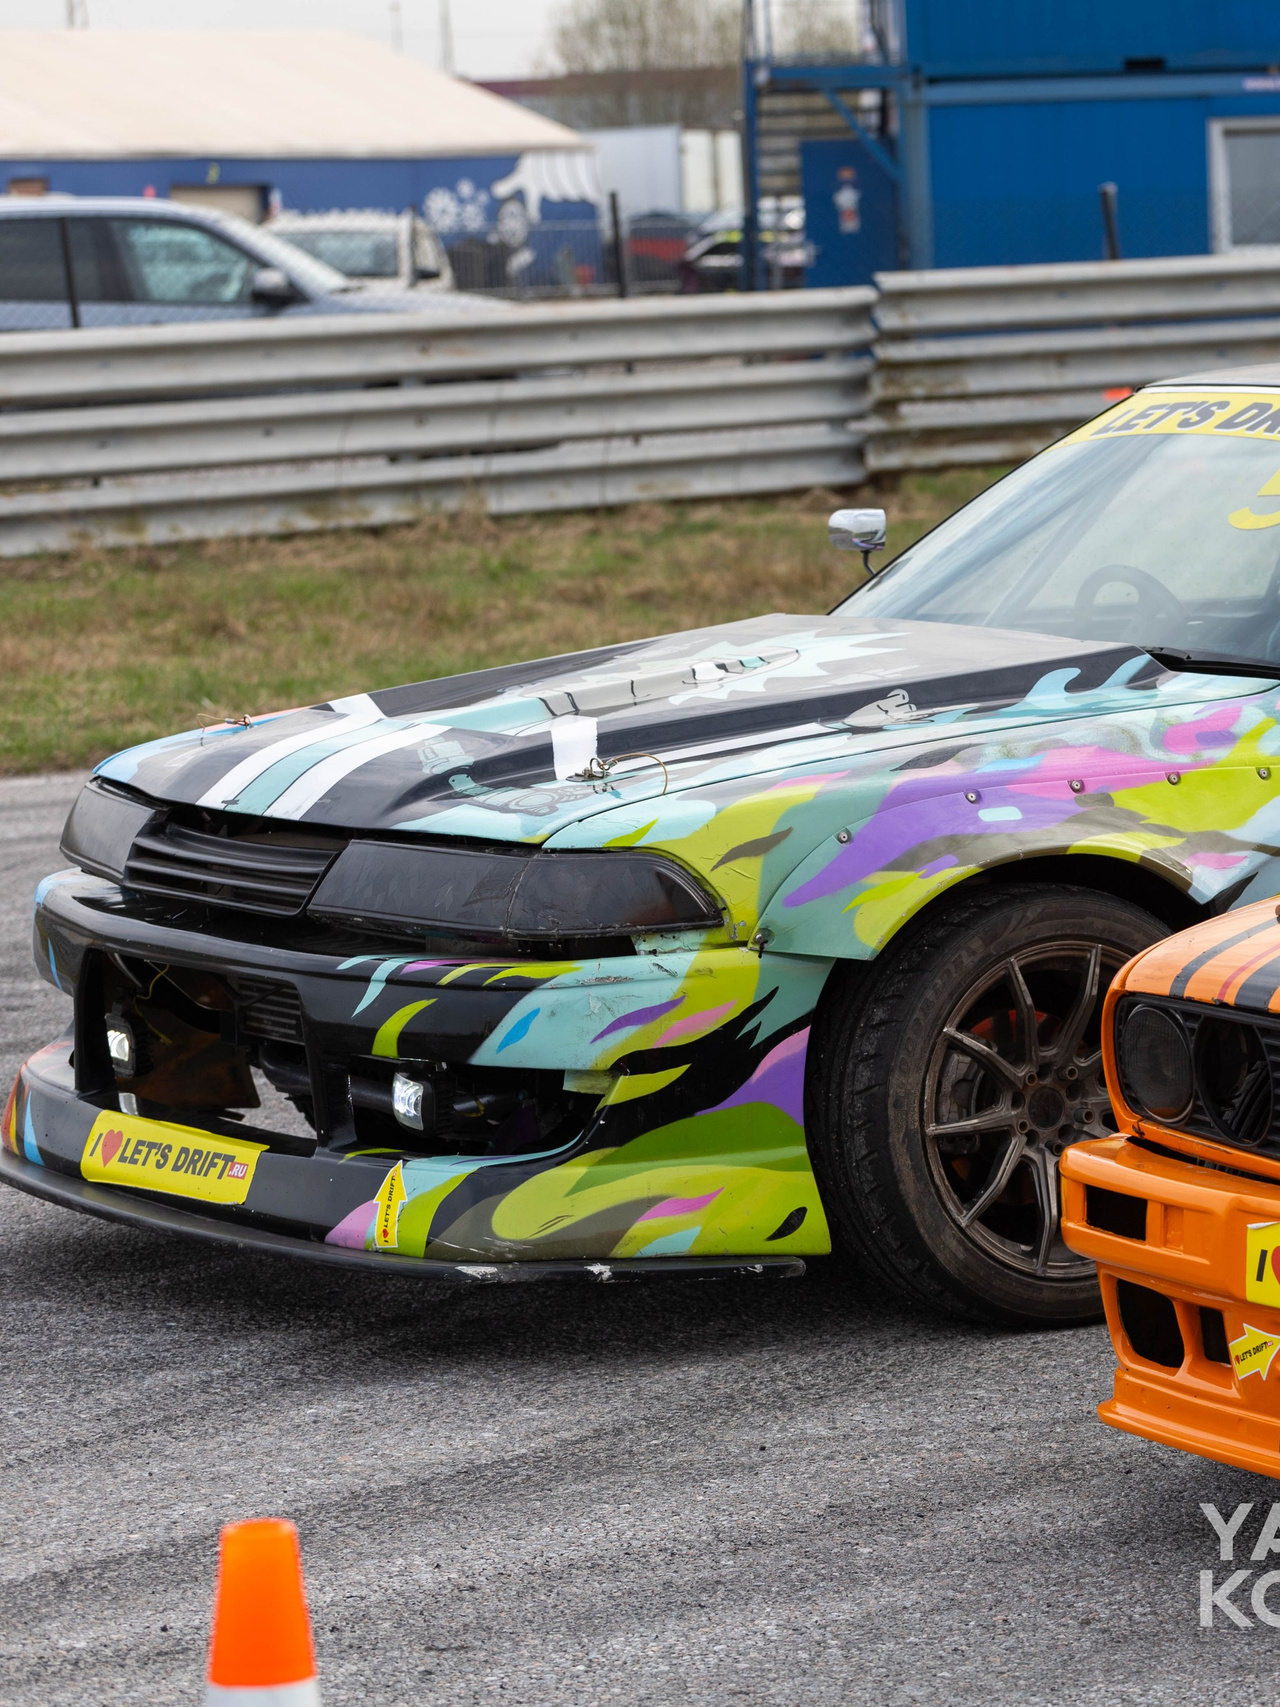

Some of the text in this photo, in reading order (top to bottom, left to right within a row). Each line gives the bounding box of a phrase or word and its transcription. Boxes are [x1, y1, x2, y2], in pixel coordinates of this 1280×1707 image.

[1090, 400, 1230, 437] LET'S
[89, 1132, 104, 1157] I
[117, 1137, 173, 1170] LET'S
[1256, 1249, 1268, 1282] I
